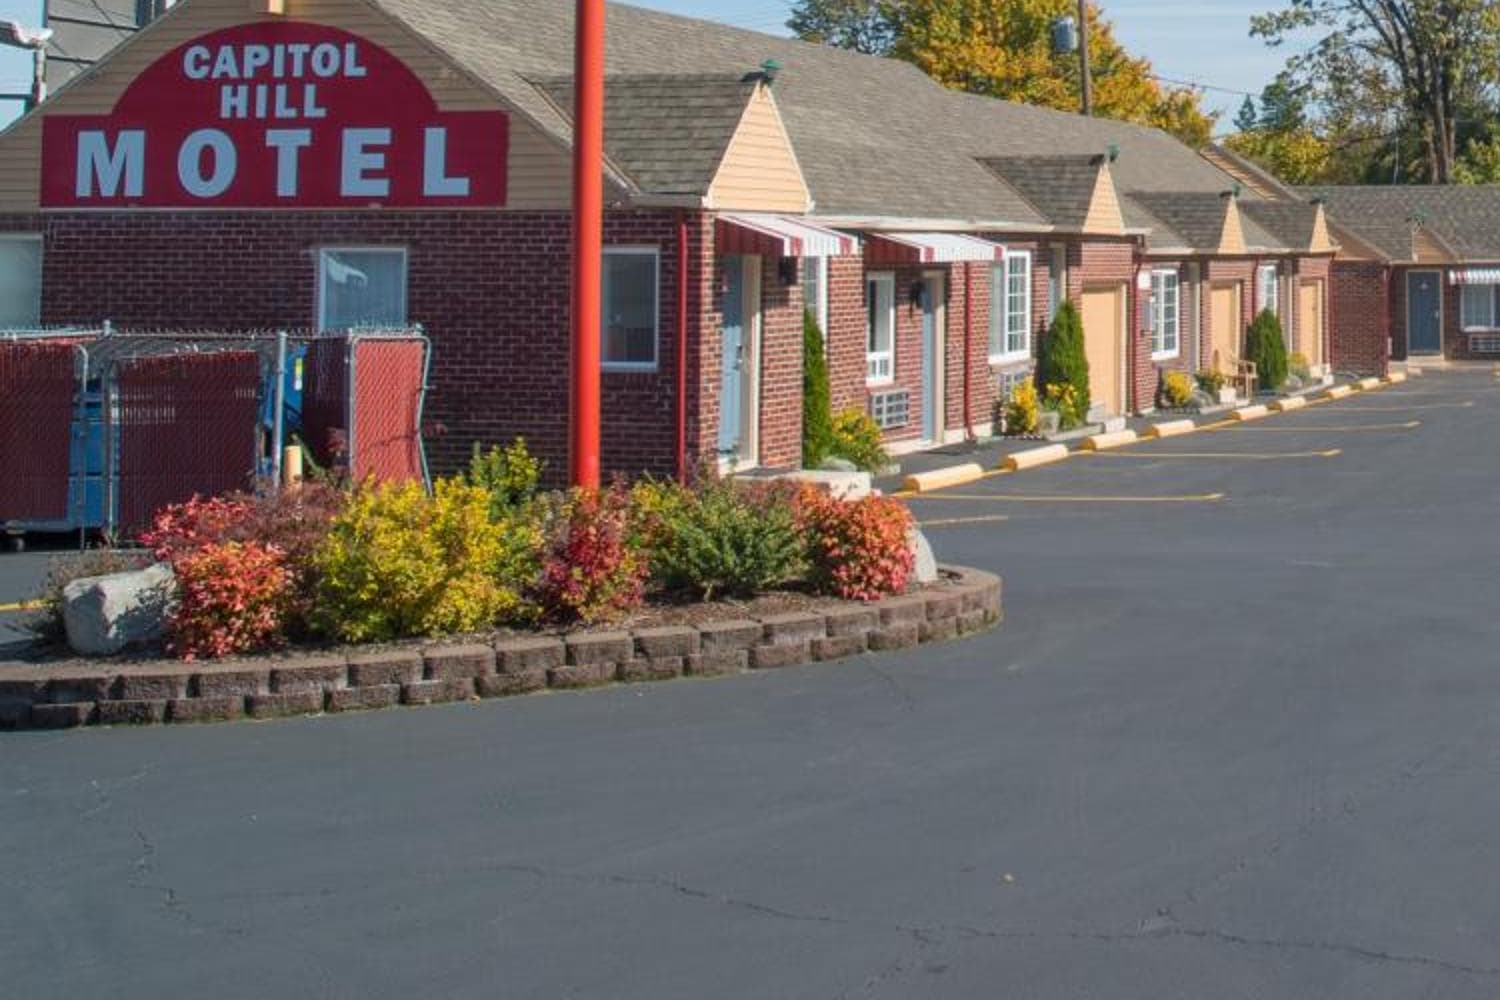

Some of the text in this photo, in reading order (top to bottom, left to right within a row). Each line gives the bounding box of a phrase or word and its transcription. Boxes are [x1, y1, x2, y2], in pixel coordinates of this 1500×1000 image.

[182, 41, 367, 79] CAPITOL
[219, 84, 327, 119] HILL
[74, 126, 471, 199] MOTEL
